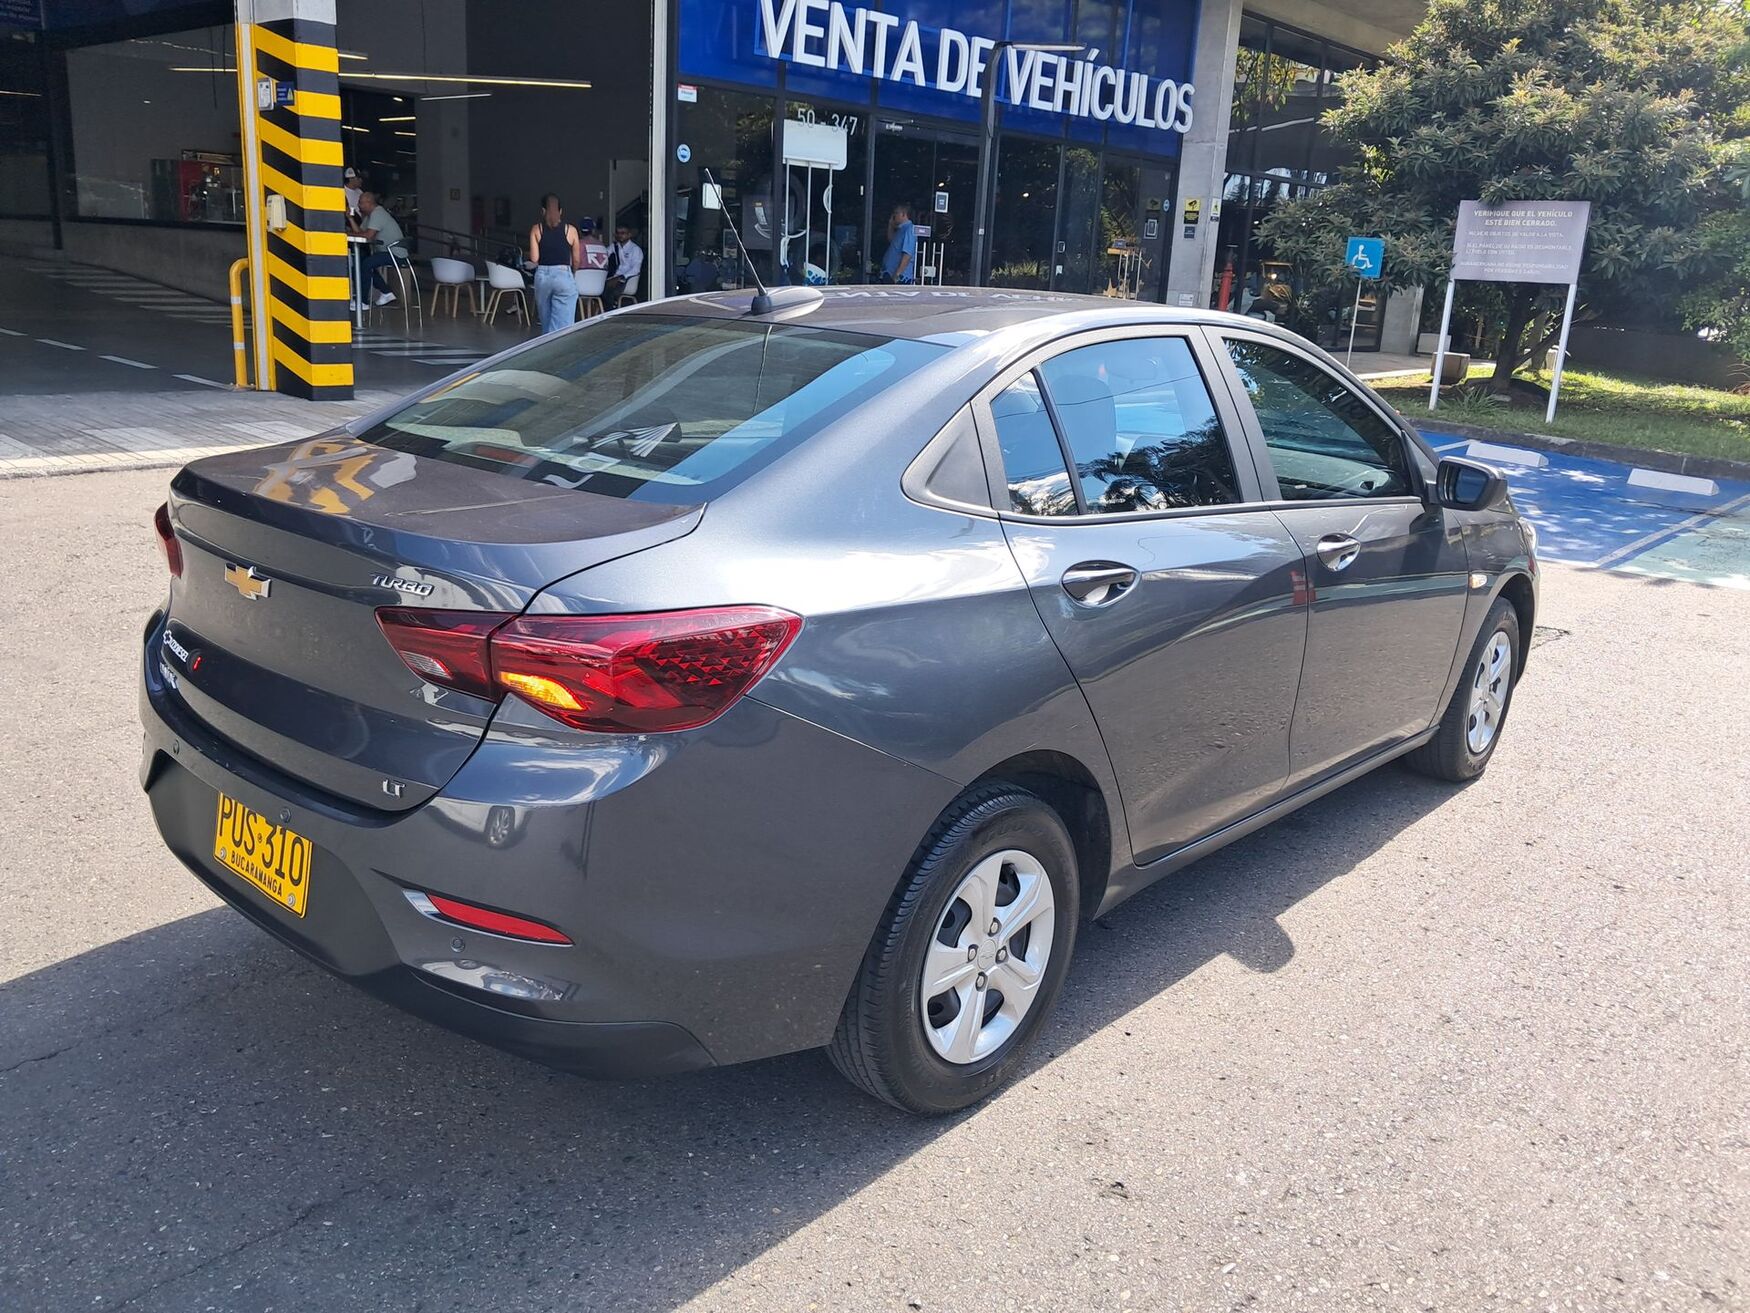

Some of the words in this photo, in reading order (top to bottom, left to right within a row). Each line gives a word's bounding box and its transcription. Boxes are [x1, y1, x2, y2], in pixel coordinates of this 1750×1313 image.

[760, 0, 926, 88] VENTA
[936, 28, 997, 98] DE
[1006, 45, 1196, 134] VEHÍCULOS
[797, 108, 816, 129] 50
[831, 113, 858, 136] 347
[1473, 209, 1510, 218] VERIFIQUE
[1511, 209, 1526, 218] QUE
[1526, 210, 1536, 218] EL
[1537, 208, 1573, 218] VEHÍCULO
[370, 574, 435, 597] TURBO
[382, 778, 407, 799] LT
[219, 796, 259, 857] PUS
[261, 823, 305, 888] 310
[230, 850, 284, 898] BUCARAMANGA
